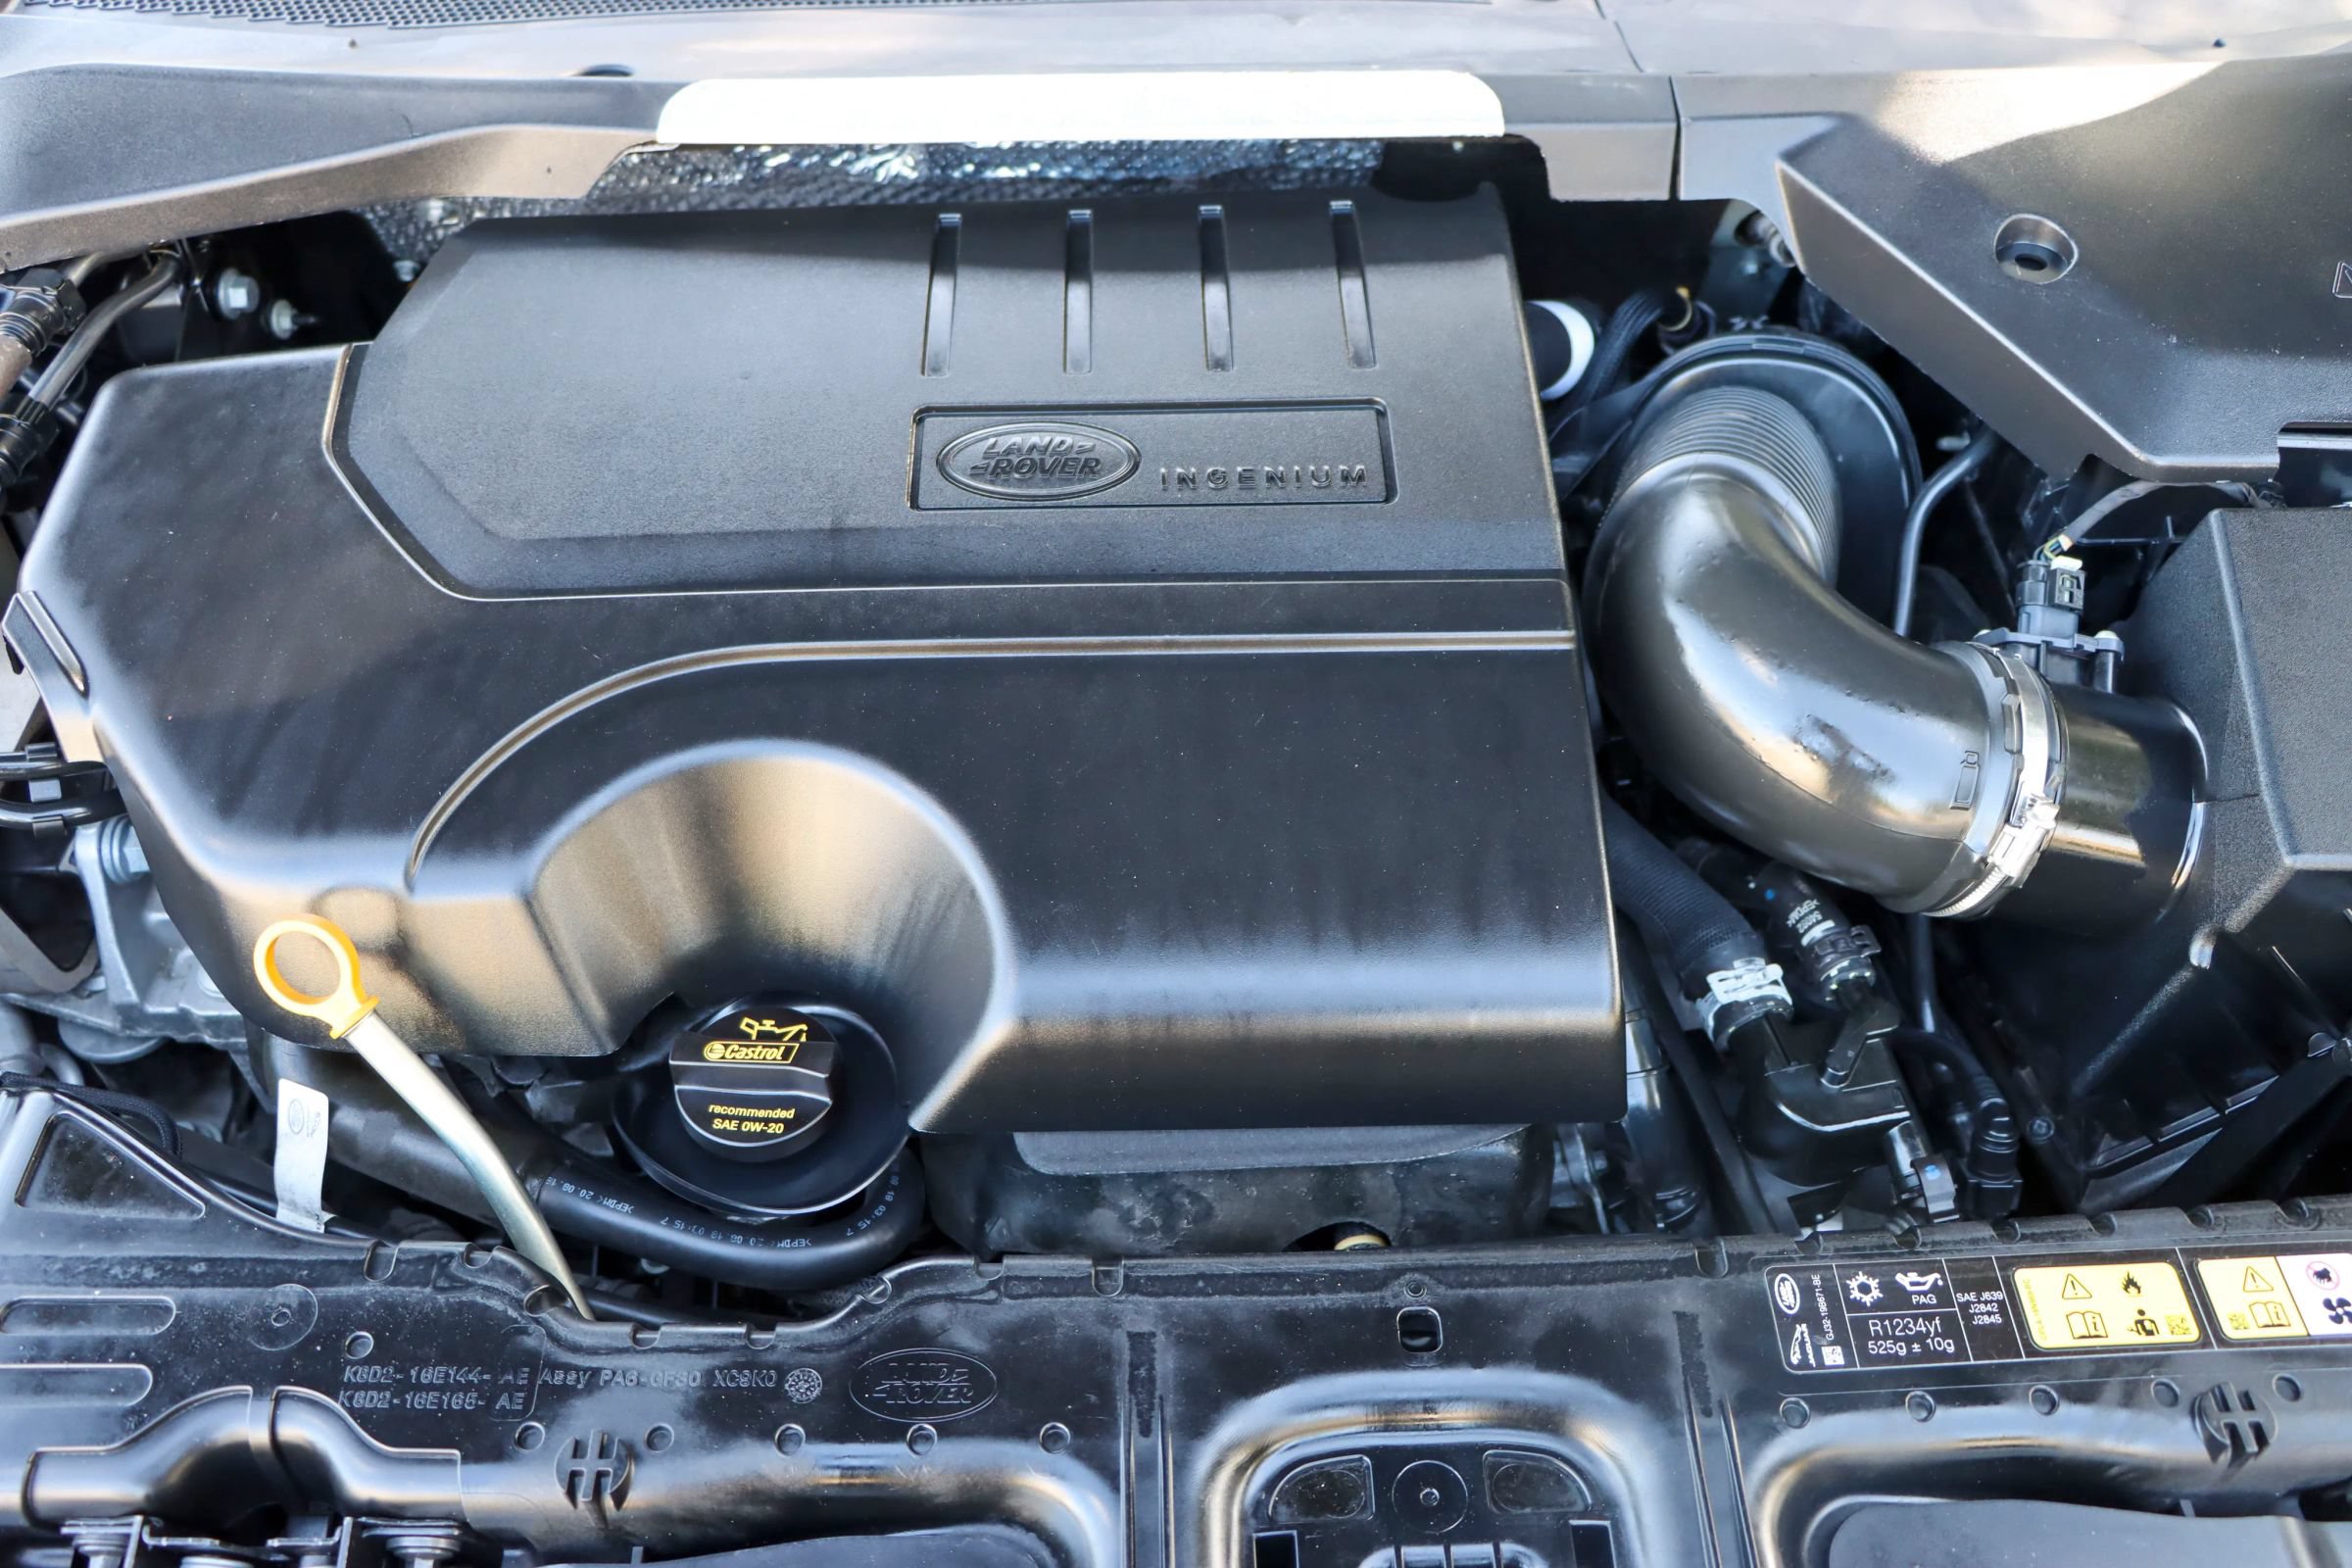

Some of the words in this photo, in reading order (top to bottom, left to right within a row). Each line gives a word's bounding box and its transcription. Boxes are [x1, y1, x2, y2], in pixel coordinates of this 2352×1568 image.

[982, 435, 1070, 457] LAND
[986, 456, 1102, 479] ROVER
[1160, 465, 1369, 489] INGENIUM
[725, 1044, 785, 1060] Castrol
[708, 1103, 796, 1119] recommended
[712, 1118, 740, 1131] SAE
[742, 1120, 785, 1134] 0W-20
[1911, 1294, 1937, 1305] PAG
[1956, 1293, 1977, 1302] SAE
[1980, 1291, 2003, 1301] J639
[1969, 1303, 1999, 1314] J2842
[1868, 1316, 1942, 1337] R1234yf
[1972, 1314, 2002, 1325] J2845
[1868, 1340, 1907, 1355] 525g
[1926, 1337, 1955, 1352] 10g
